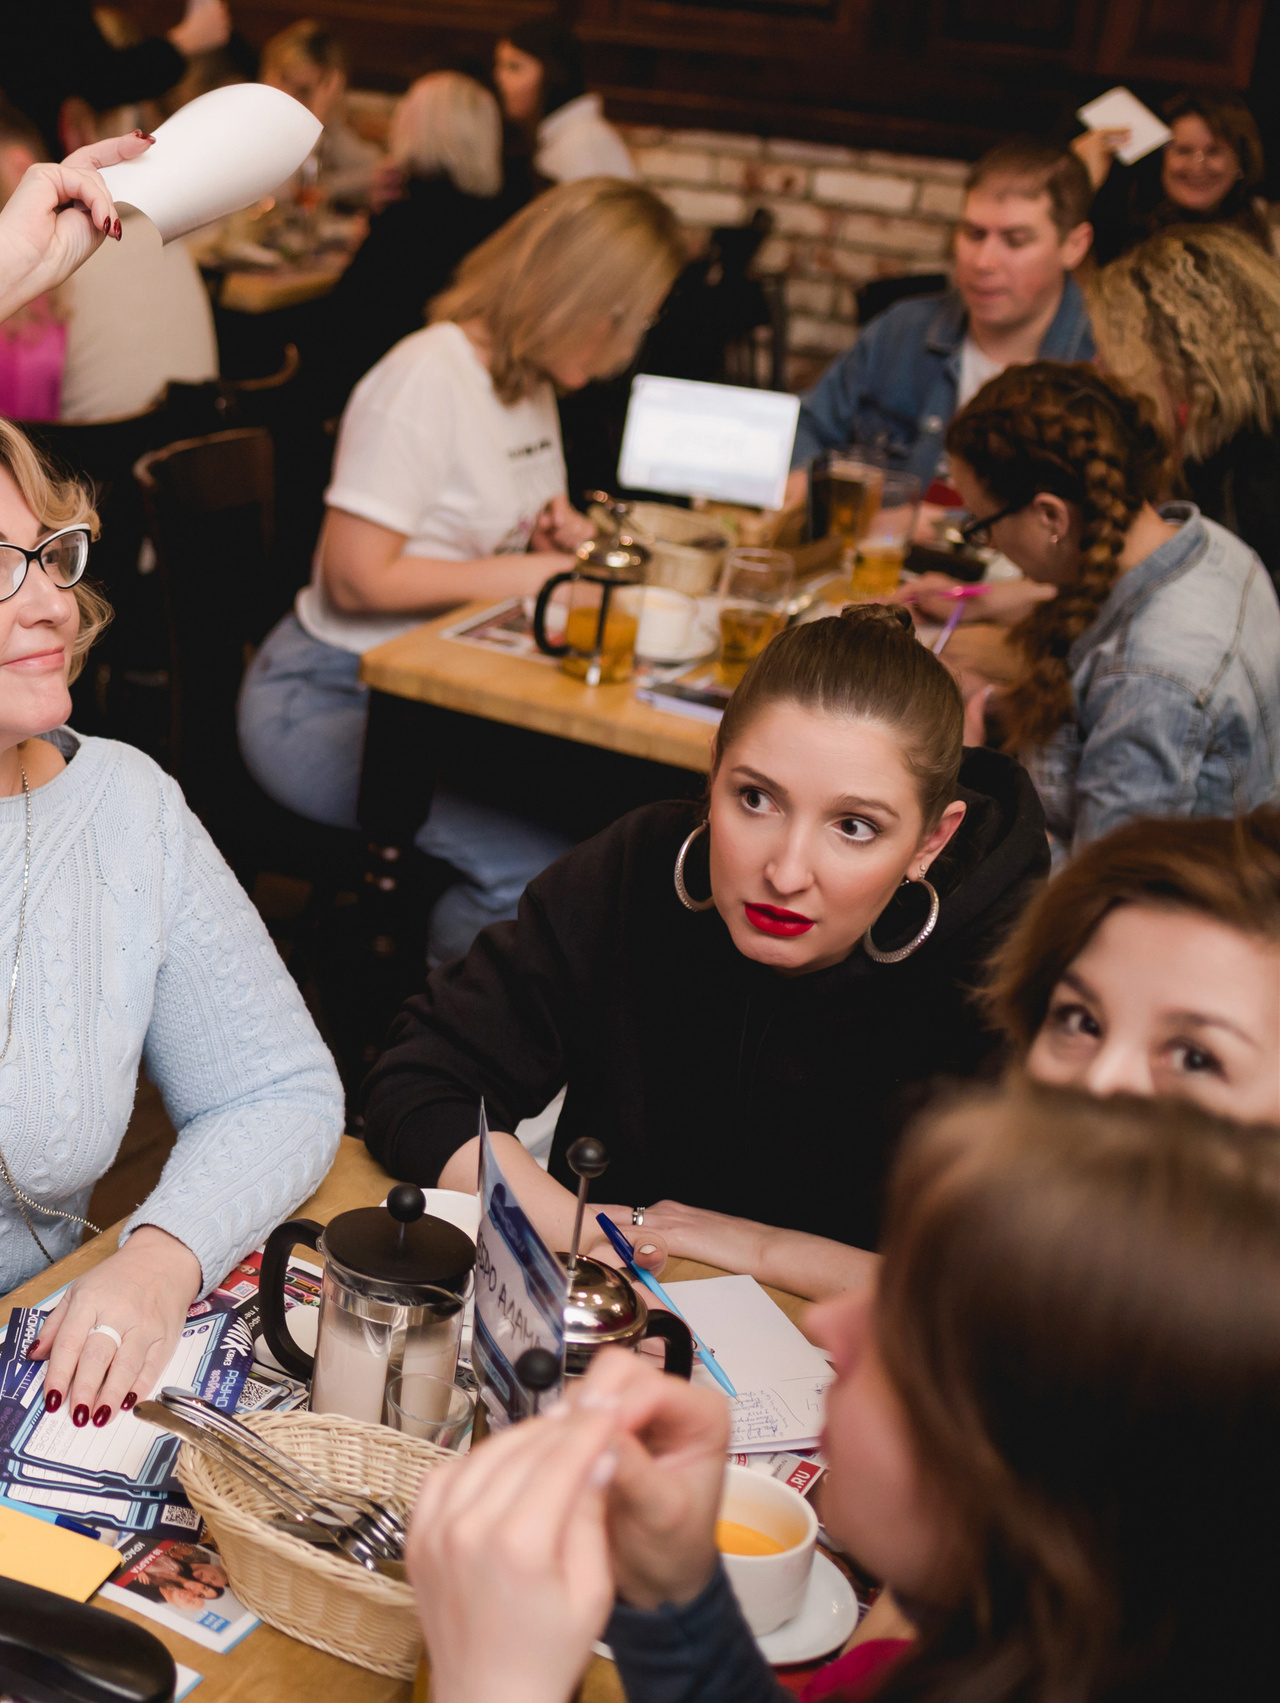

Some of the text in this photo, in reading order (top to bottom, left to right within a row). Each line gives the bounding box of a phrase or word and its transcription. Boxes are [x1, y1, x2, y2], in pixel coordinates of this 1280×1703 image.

[223, 1349, 237, 1366] КВИЗ
[214, 1369, 239, 1408] РАУНД
[130, 1552, 157, 1575] МАРТА
